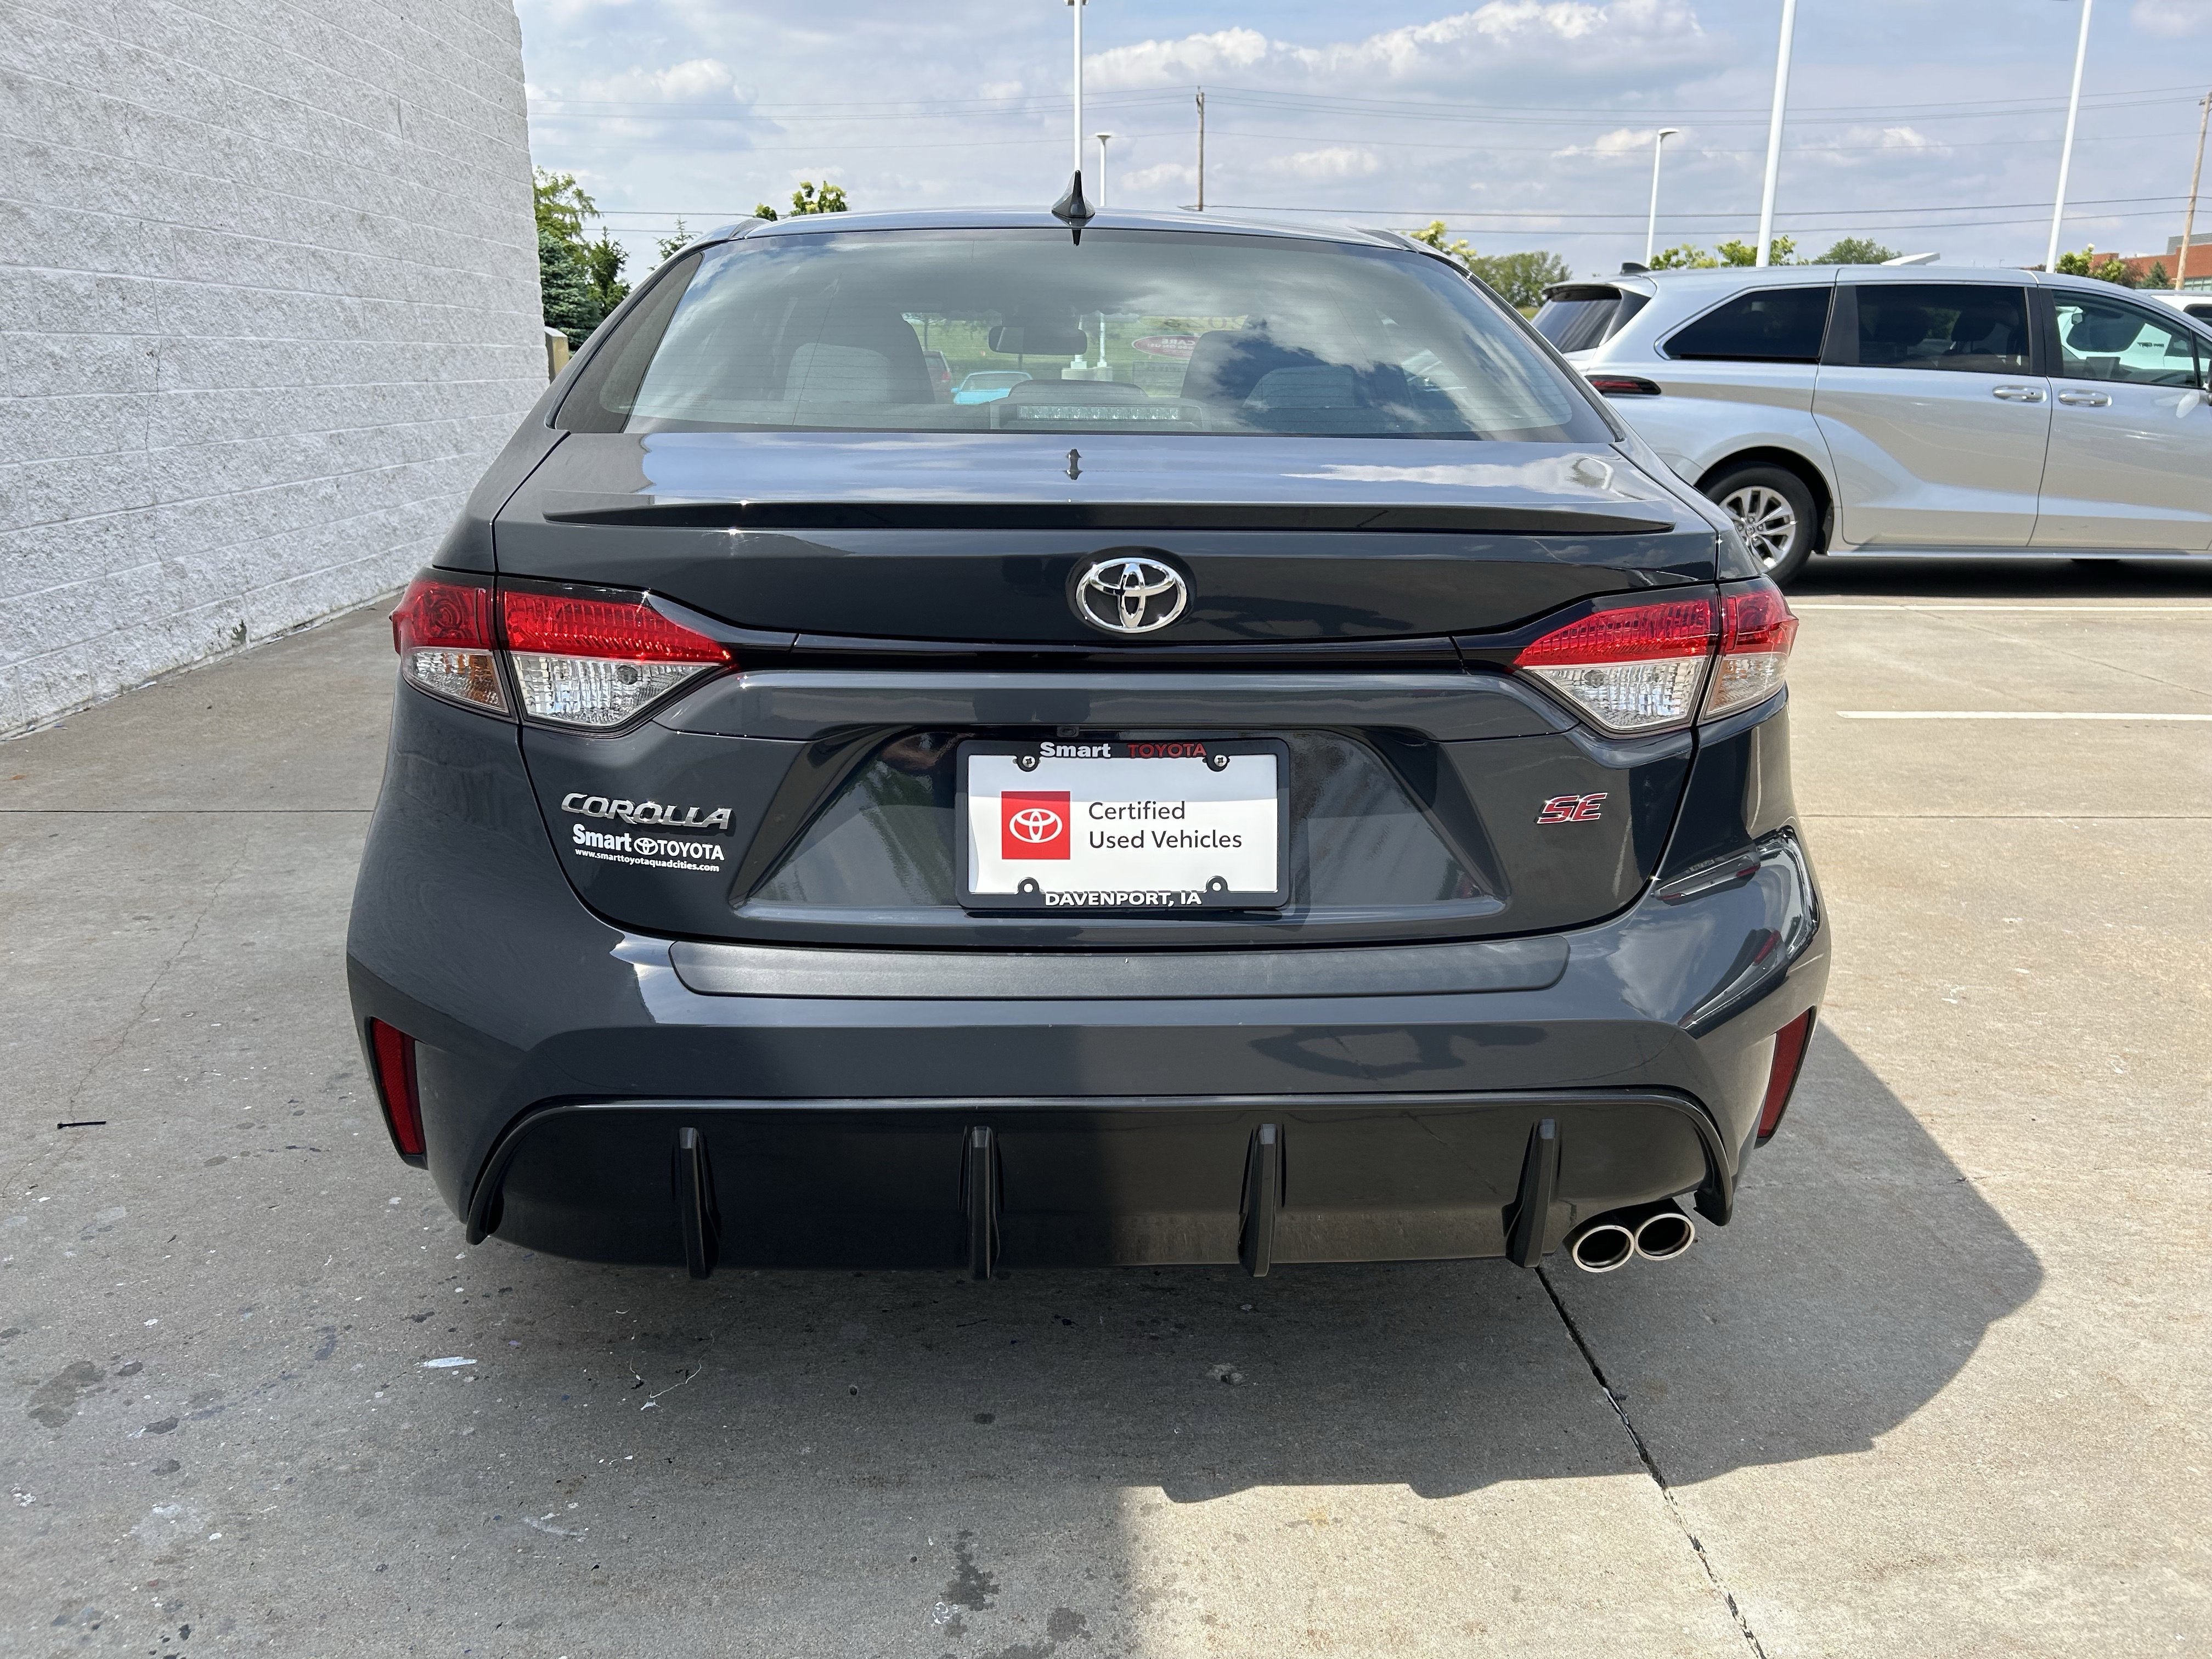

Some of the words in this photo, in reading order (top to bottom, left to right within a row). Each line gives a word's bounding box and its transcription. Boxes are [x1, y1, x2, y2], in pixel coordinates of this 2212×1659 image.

[1040, 742, 1111, 758] Smart
[1127, 743, 1207, 758] TOYOTA
[561, 793, 732, 830] COROLLA
[1089, 801, 1185, 820] Certified
[1537, 792, 1608, 824] SE
[573, 823, 632, 852] Smart
[657, 839, 725, 861] TOYOTA
[1090, 830, 1144, 848] Used
[1152, 830, 1242, 848] Vehicles
[575, 849, 719, 872] www.smarttoyotaquadcities.com
[1045, 892, 1173, 907] DAVENPORT,
[1181, 891, 1202, 905] IA
